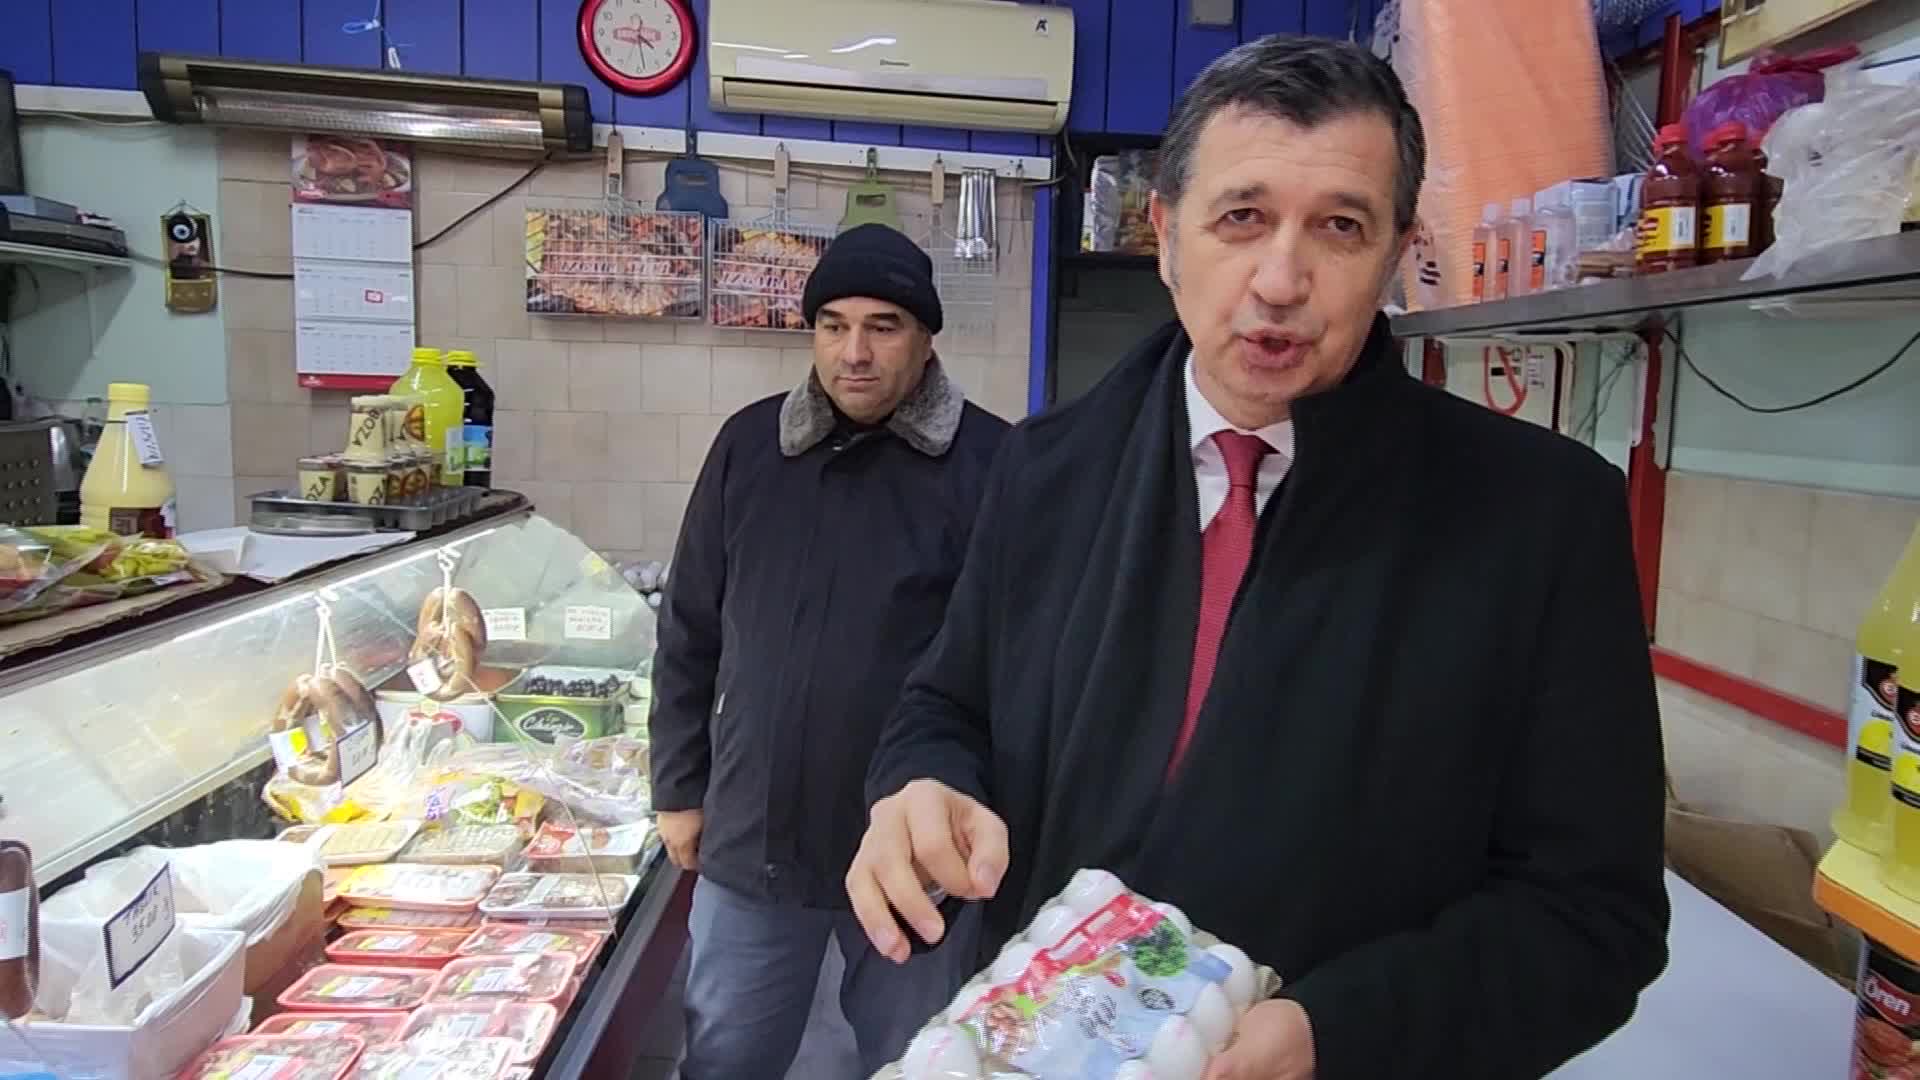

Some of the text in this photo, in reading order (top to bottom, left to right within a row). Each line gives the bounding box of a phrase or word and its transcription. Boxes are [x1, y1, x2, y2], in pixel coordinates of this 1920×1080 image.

[665, 14, 673, 24] 2
[305, 475, 332, 501] OZA
[1863, 975, 1912, 1017] Ören
